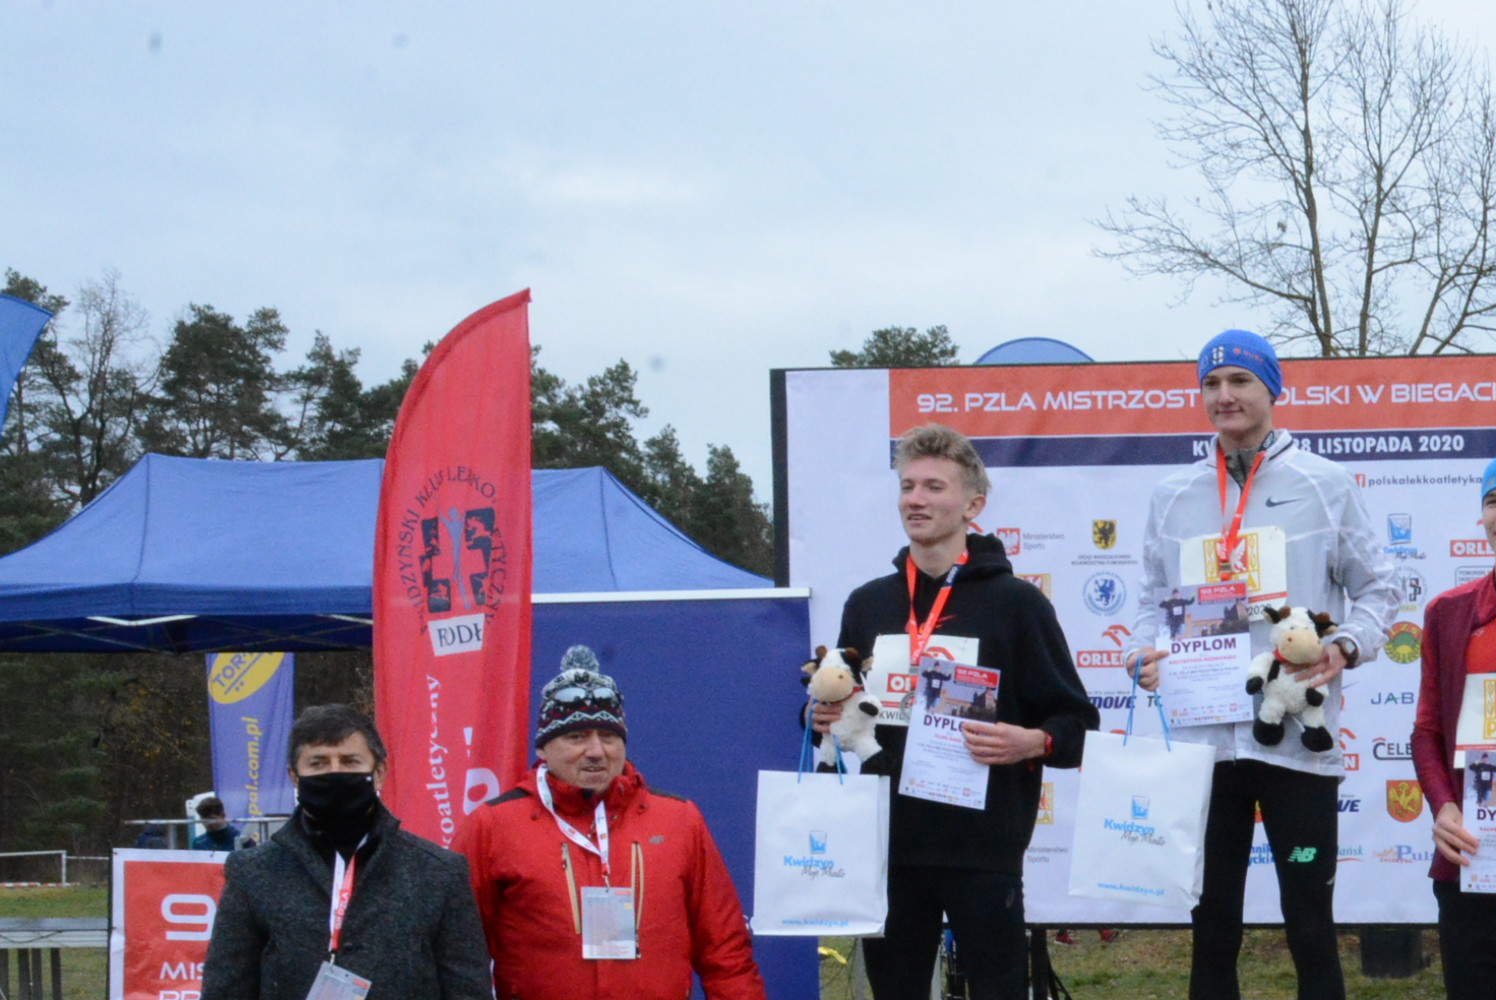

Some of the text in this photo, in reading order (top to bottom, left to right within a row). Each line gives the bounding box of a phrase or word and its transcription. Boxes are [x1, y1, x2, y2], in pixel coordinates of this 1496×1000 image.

[917, 393, 958, 413] 92.
[965, 391, 1036, 411] PZLA
[1042, 386, 1201, 411] MISTRZOST
[1275, 384, 1349, 406] OLSKI
[1357, 385, 1384, 404] W
[1318, 435, 1414, 454] LISTOPADA
[1418, 434, 1465, 453] 2020
[1368, 474, 1483, 488] polskalekkoatletyka
[1453, 542, 1495, 555] ORL
[1171, 637, 1237, 655] DYPLOM
[1079, 652, 1124, 666] ORLE
[923, 714, 964, 732] DYPL
[1104, 819, 1155, 836] Kwidzyn
[783, 855, 834, 869] Kwidzyn
